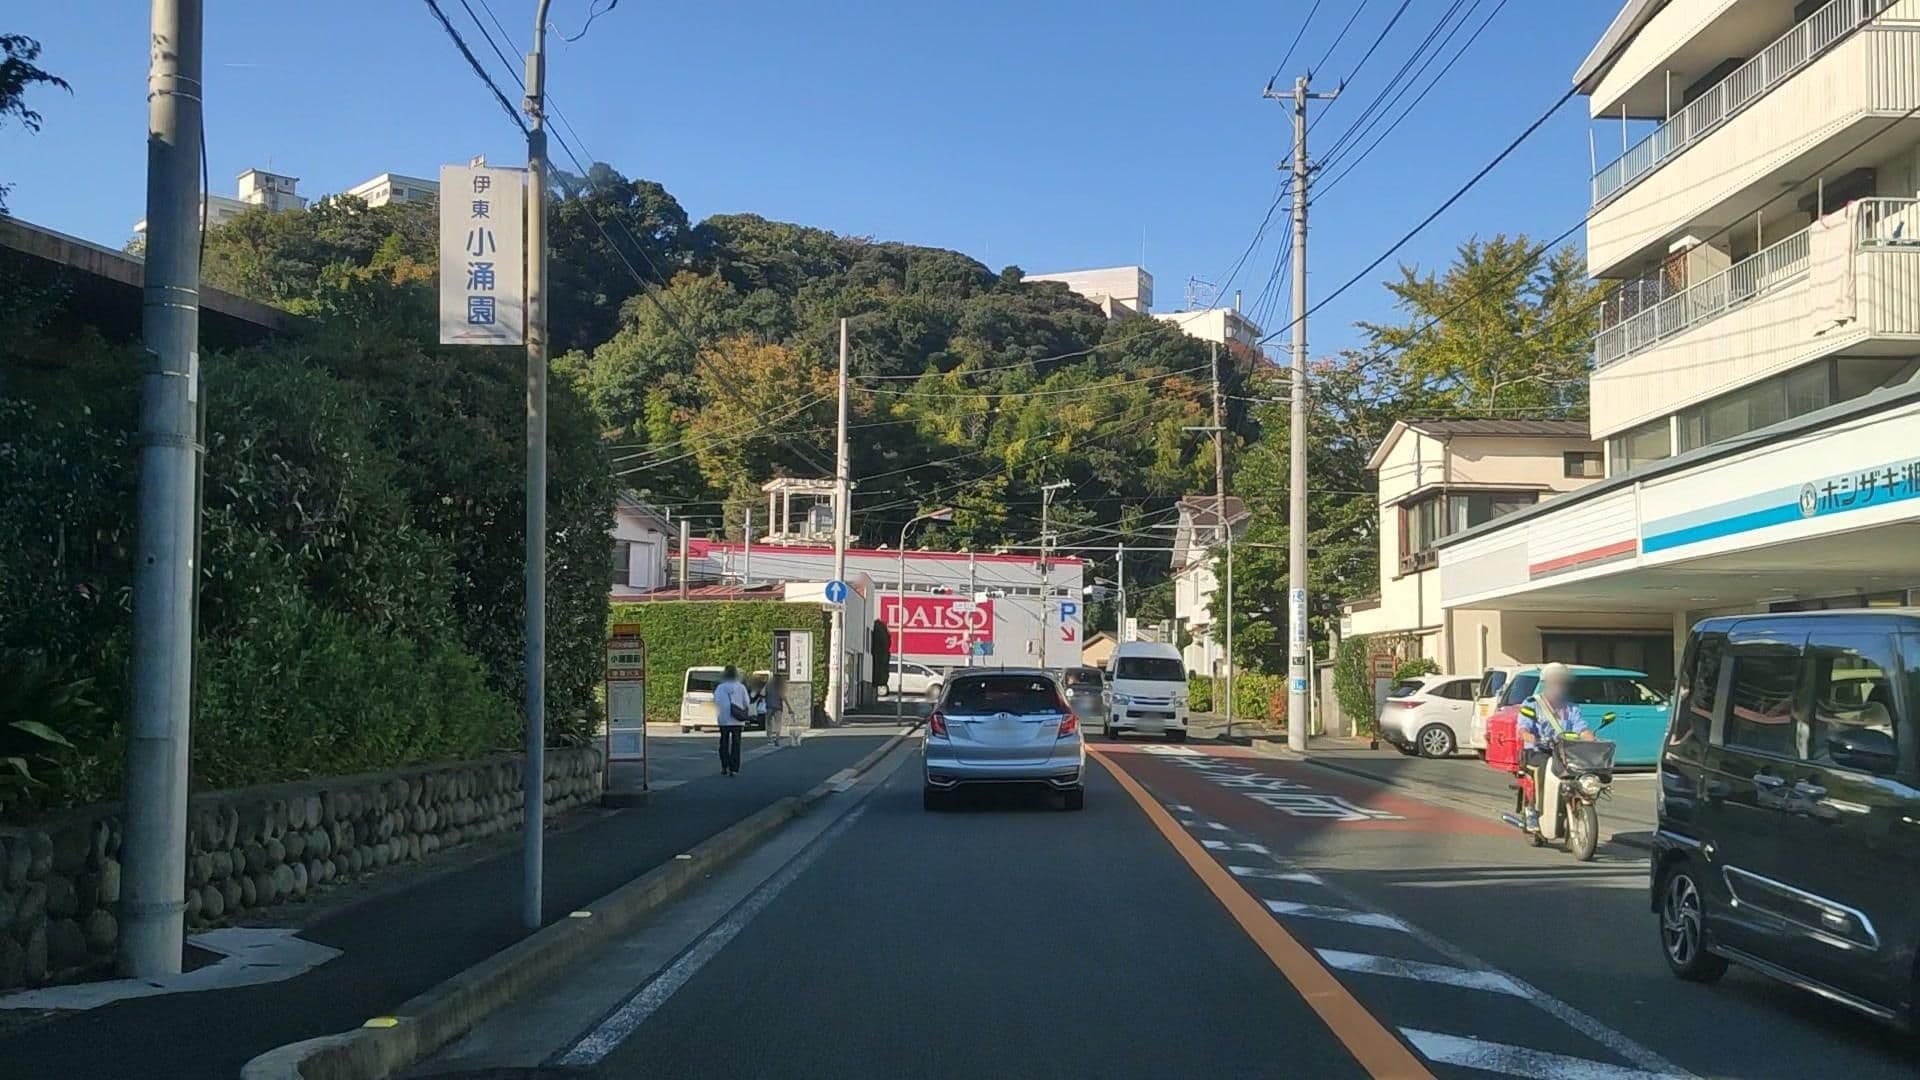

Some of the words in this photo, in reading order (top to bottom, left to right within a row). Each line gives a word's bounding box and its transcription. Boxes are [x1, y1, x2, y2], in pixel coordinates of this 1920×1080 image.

[466, 175, 496, 324] 伊東小涌園
[886, 604, 988, 629] DAISO
[1061, 603, 1076, 622] P
